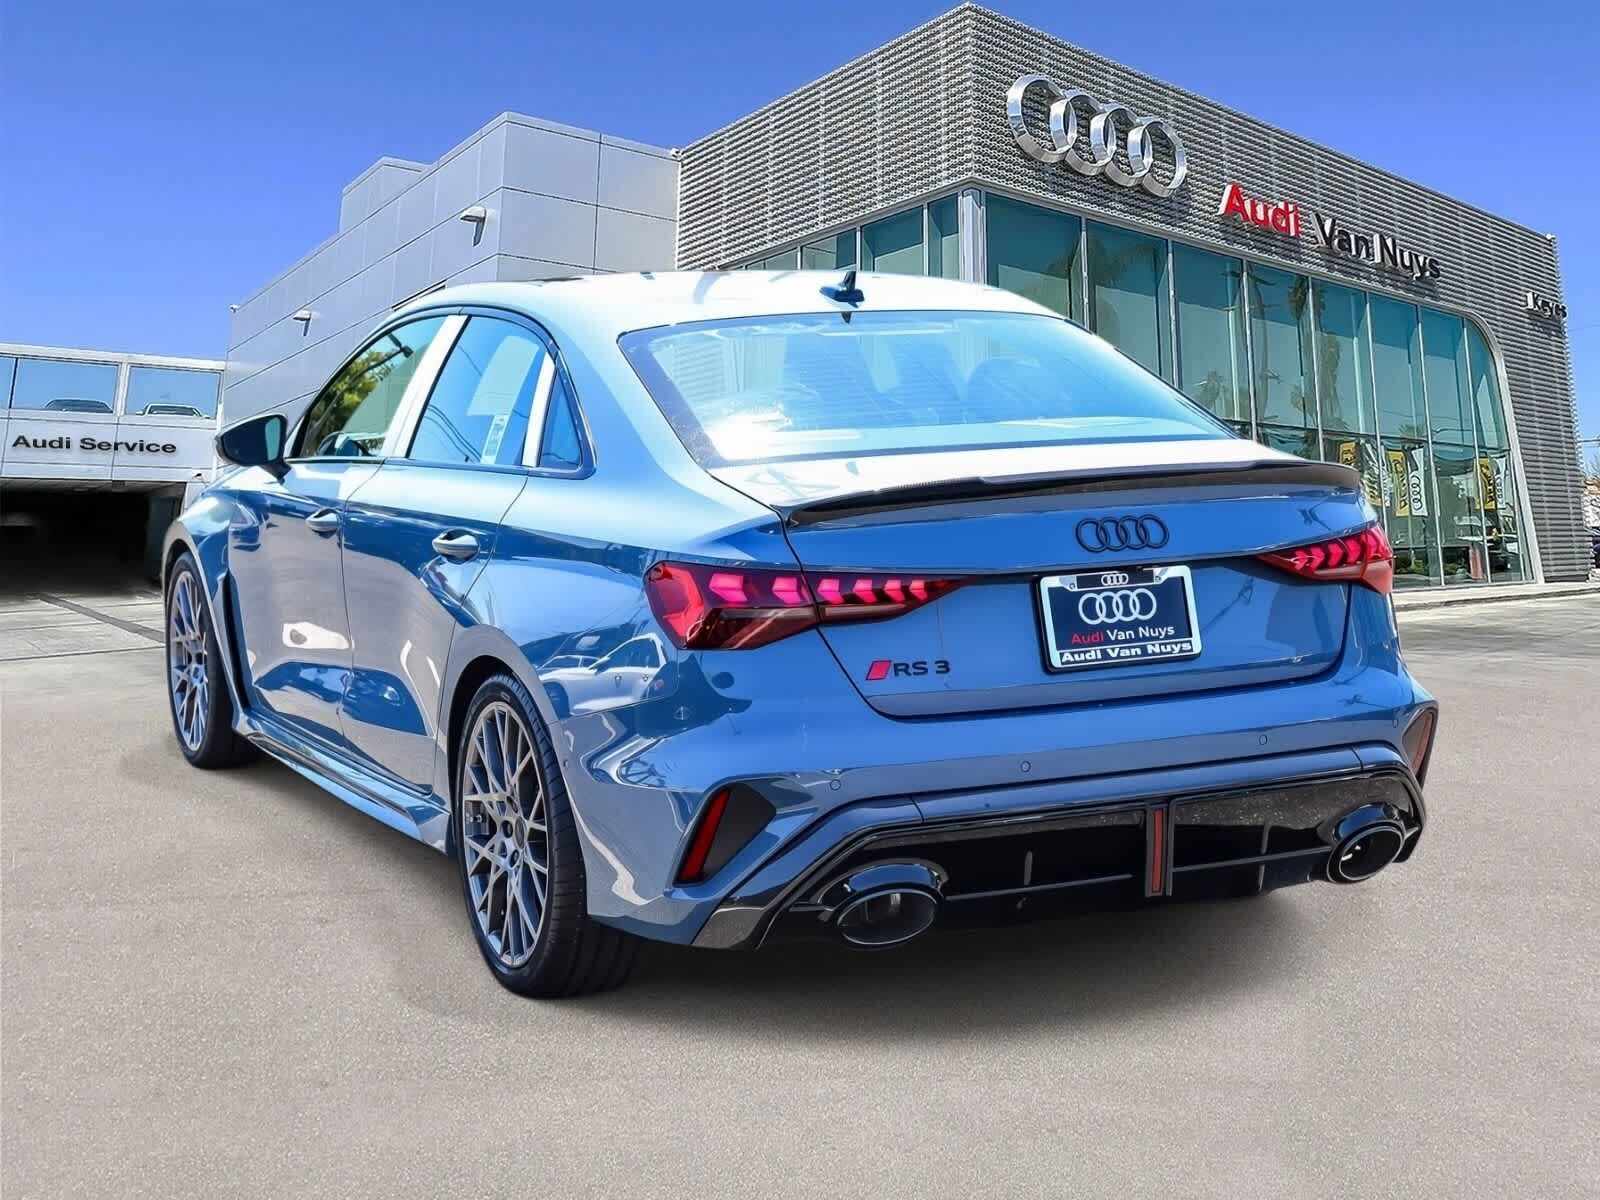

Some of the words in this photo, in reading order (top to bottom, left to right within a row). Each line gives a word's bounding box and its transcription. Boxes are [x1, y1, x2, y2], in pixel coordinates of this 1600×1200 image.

[1218, 182, 1303, 238] Audi
[1311, 211, 1372, 259] Van
[1373, 233, 1442, 281] Nuys
[12, 434, 71, 450] Audi
[80, 437, 177, 454] Service
[1071, 631, 1104, 645] Audi
[1106, 628, 1135, 641] Van
[1138, 625, 1175, 640] Nuys
[1061, 649, 1102, 663] Audi
[1106, 645, 1142, 658] Van
[1146, 641, 1193, 655] Nuys
[893, 661, 929, 677] RS
[934, 660, 951, 674] 3
